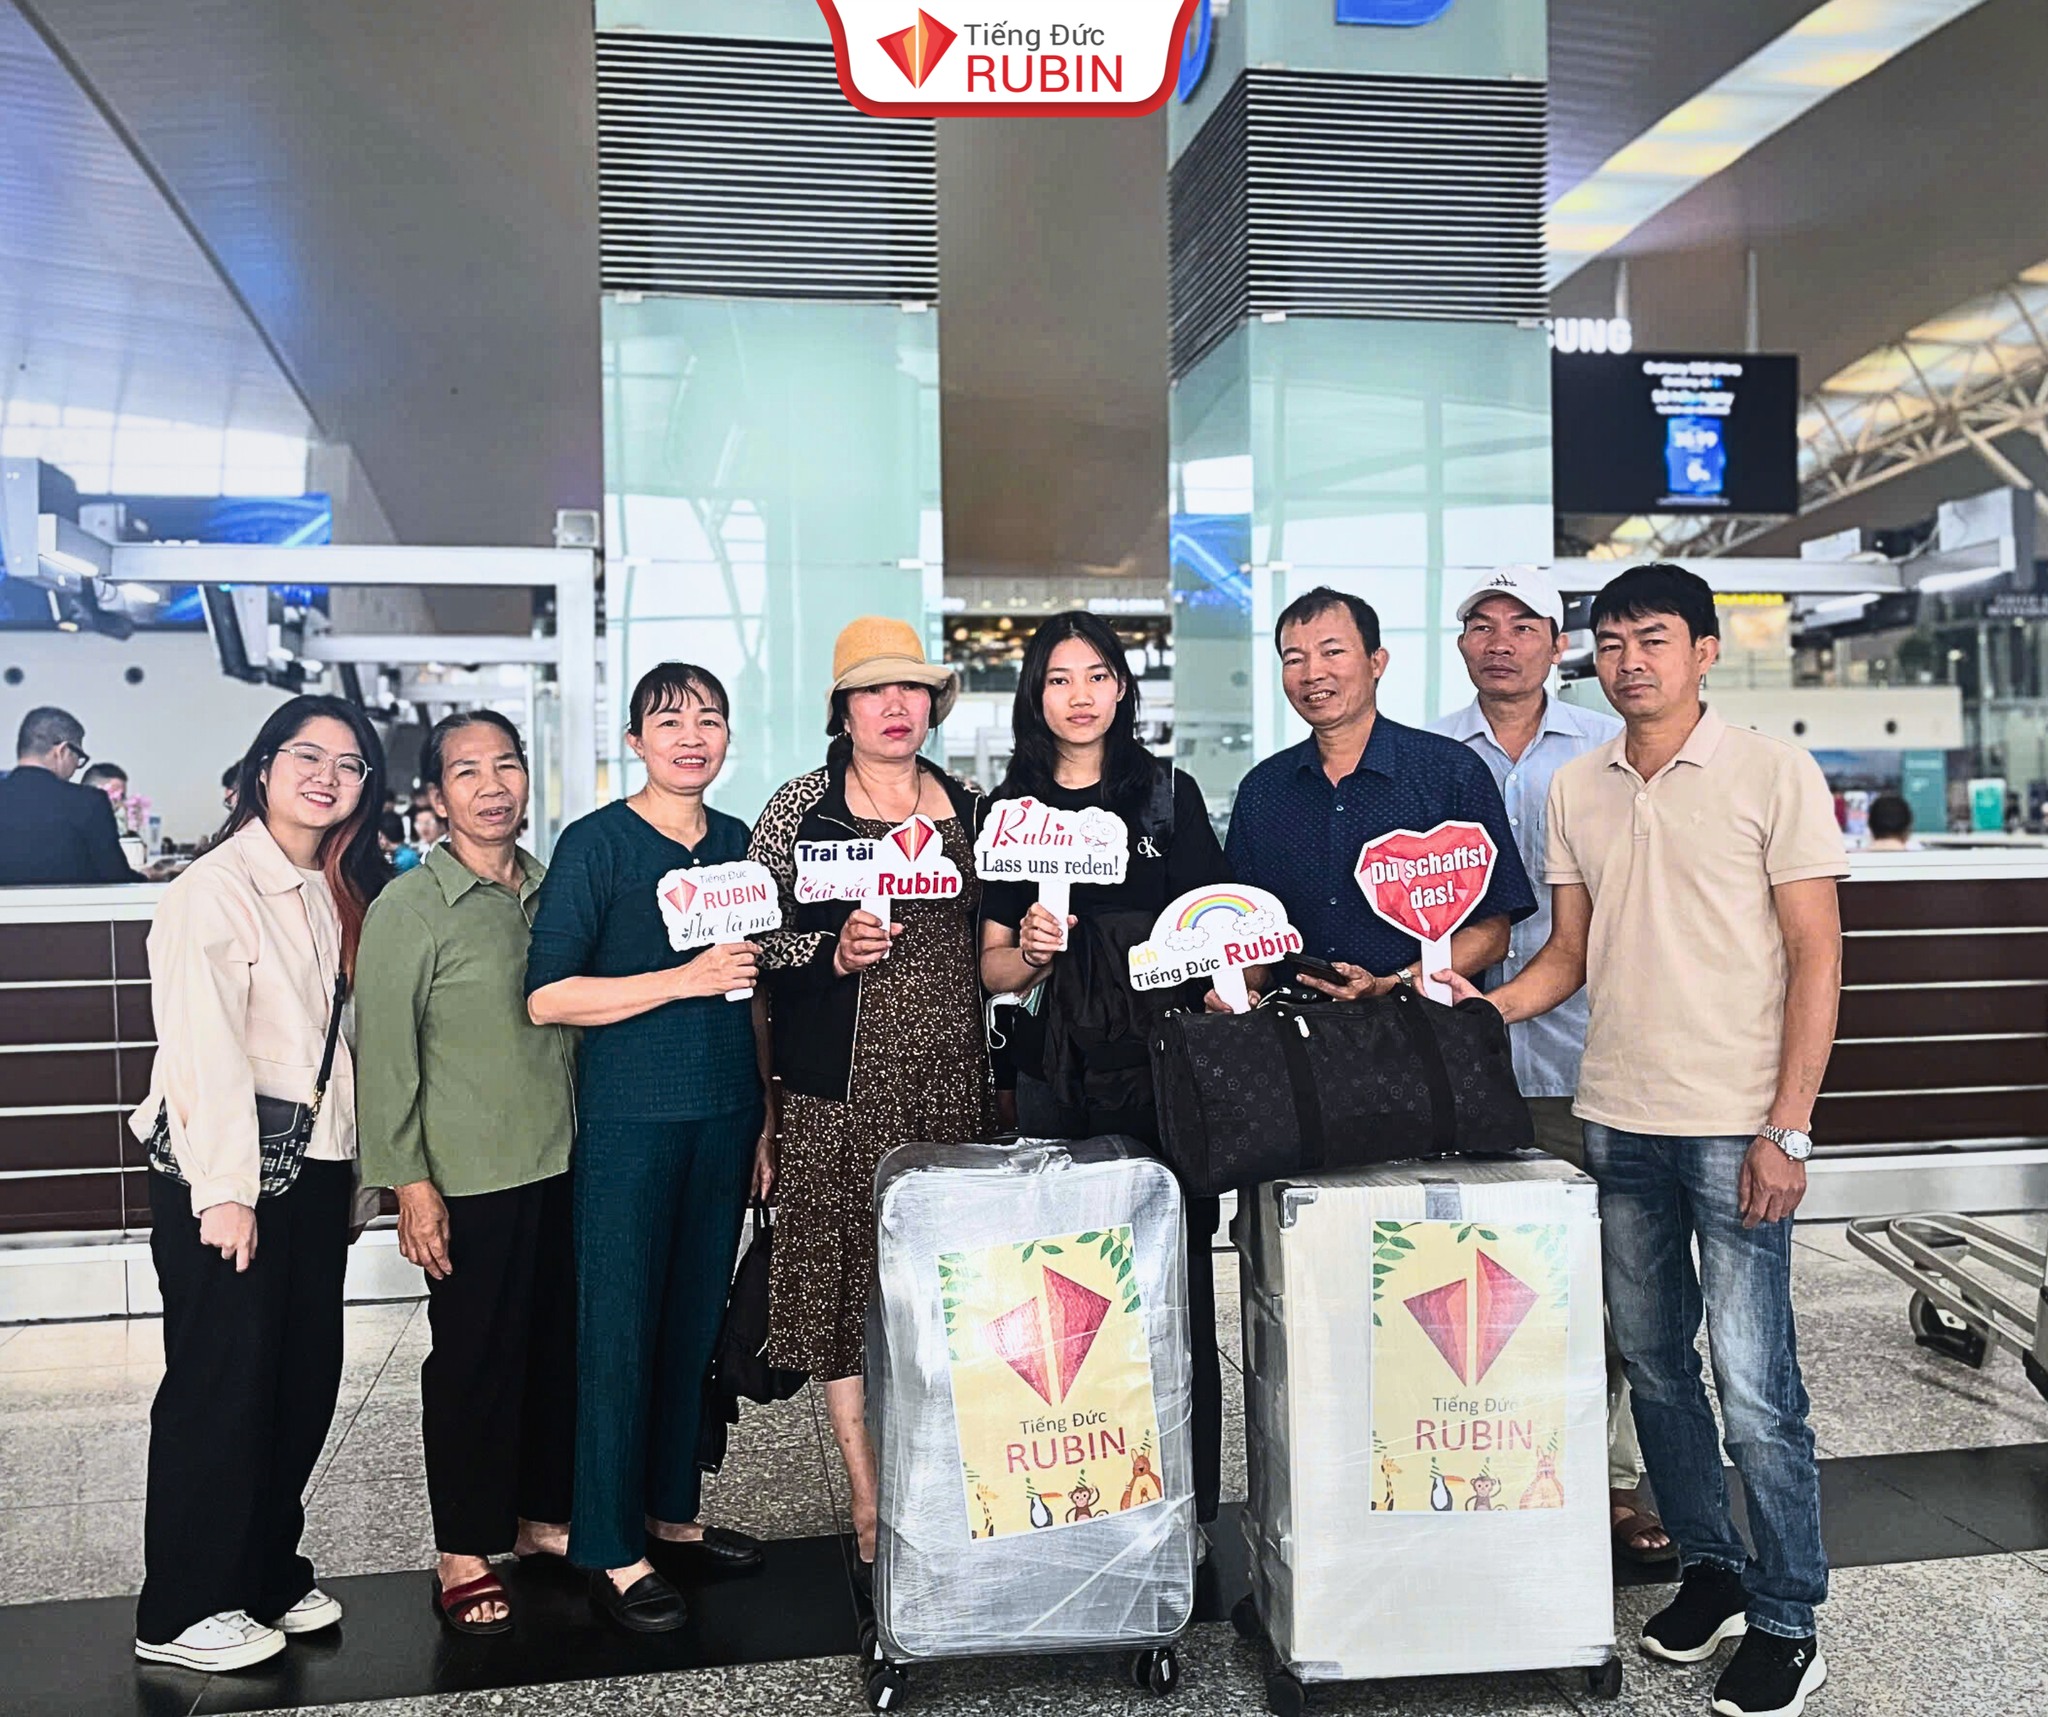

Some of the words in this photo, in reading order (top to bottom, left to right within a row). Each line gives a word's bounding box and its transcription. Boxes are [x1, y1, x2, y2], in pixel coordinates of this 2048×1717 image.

[992, 801, 1073, 848] Rubin
[798, 843, 838, 863] Trai
[845, 842, 874, 861] tài
[981, 850, 1023, 873] Lass
[1028, 859, 1060, 875] uns
[1064, 854, 1119, 877] reden!
[1370, 860, 1400, 886] Du
[1403, 843, 1488, 880] schaffst
[703, 883, 767, 910] RUBIN
[877, 871, 958, 896] Rubin
[1409, 880, 1455, 911] das!
[726, 911, 744, 933] là
[749, 910, 776, 929] mê
[1132, 966, 1182, 988] Tiếng
[1185, 957, 1221, 976] Đức
[1224, 931, 1300, 966] Rubin
[1432, 1395, 1480, 1416] Tiếng
[1019, 1415, 1068, 1435] Tiếng
[1072, 1409, 1108, 1427] Đức
[1416, 1419, 1532, 1451] RUBIN
[1006, 1426, 1126, 1474] RUBIN
